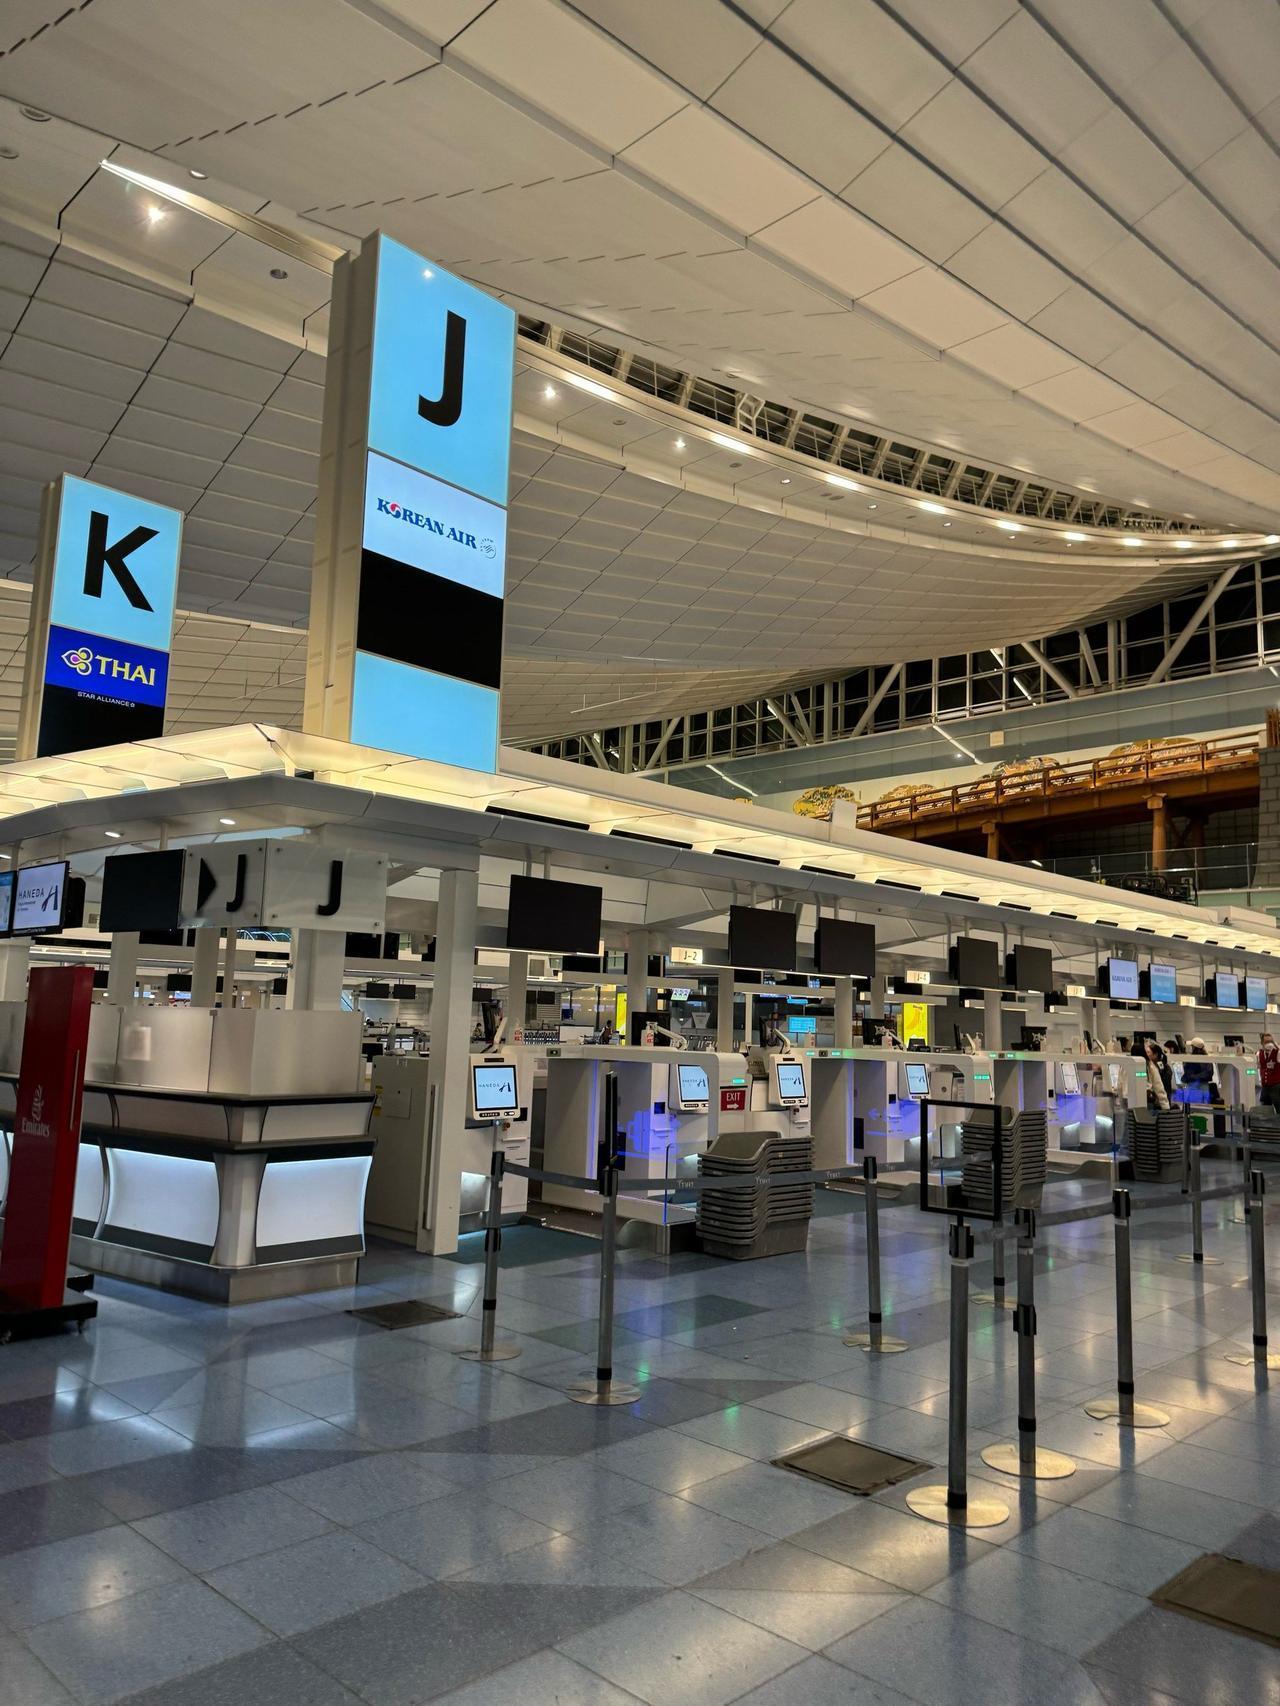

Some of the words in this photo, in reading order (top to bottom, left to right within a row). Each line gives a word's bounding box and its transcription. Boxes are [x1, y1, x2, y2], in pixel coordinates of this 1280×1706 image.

[418, 311, 466, 427] J
[377, 498, 444, 535] KOREAN
[446, 527, 477, 549] AIR
[83, 510, 160, 613] K
[95, 655, 156, 686] THAI
[77, 691, 96, 700] STAR
[97, 695, 130, 707] ALLIANCE
[19, 888, 45, 899] HANEDA
[226, 854, 247, 912] J
[317, 860, 343, 916] J
[683, 950, 697, 961] J-2
[726, 1092, 741, 1102] EXIT
[22, 1117, 50, 1137] Emirates
